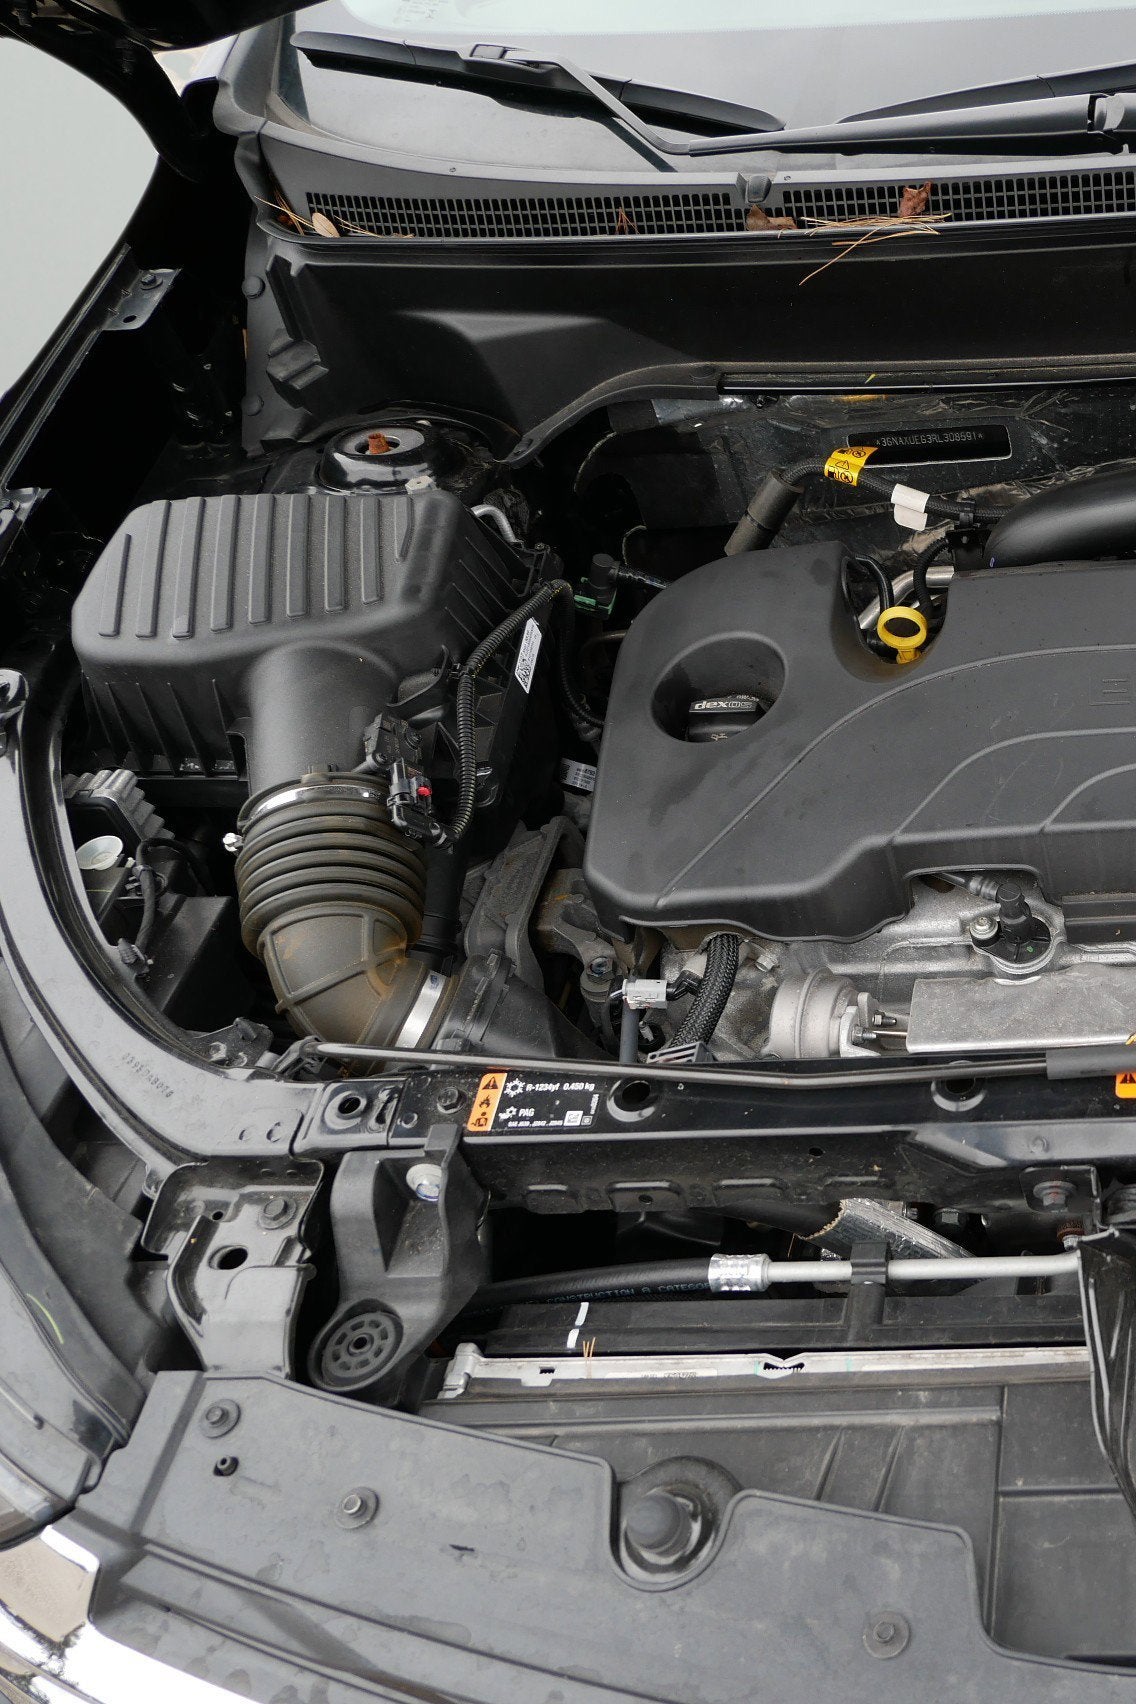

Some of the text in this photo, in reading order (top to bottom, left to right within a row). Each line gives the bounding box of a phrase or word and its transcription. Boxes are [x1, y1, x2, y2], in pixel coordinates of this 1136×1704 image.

[694, 700, 753, 710] dexos
[525, 1083, 595, 1093] R-1234yf 0.450 kg
[518, 1108, 535, 1117] PAG
